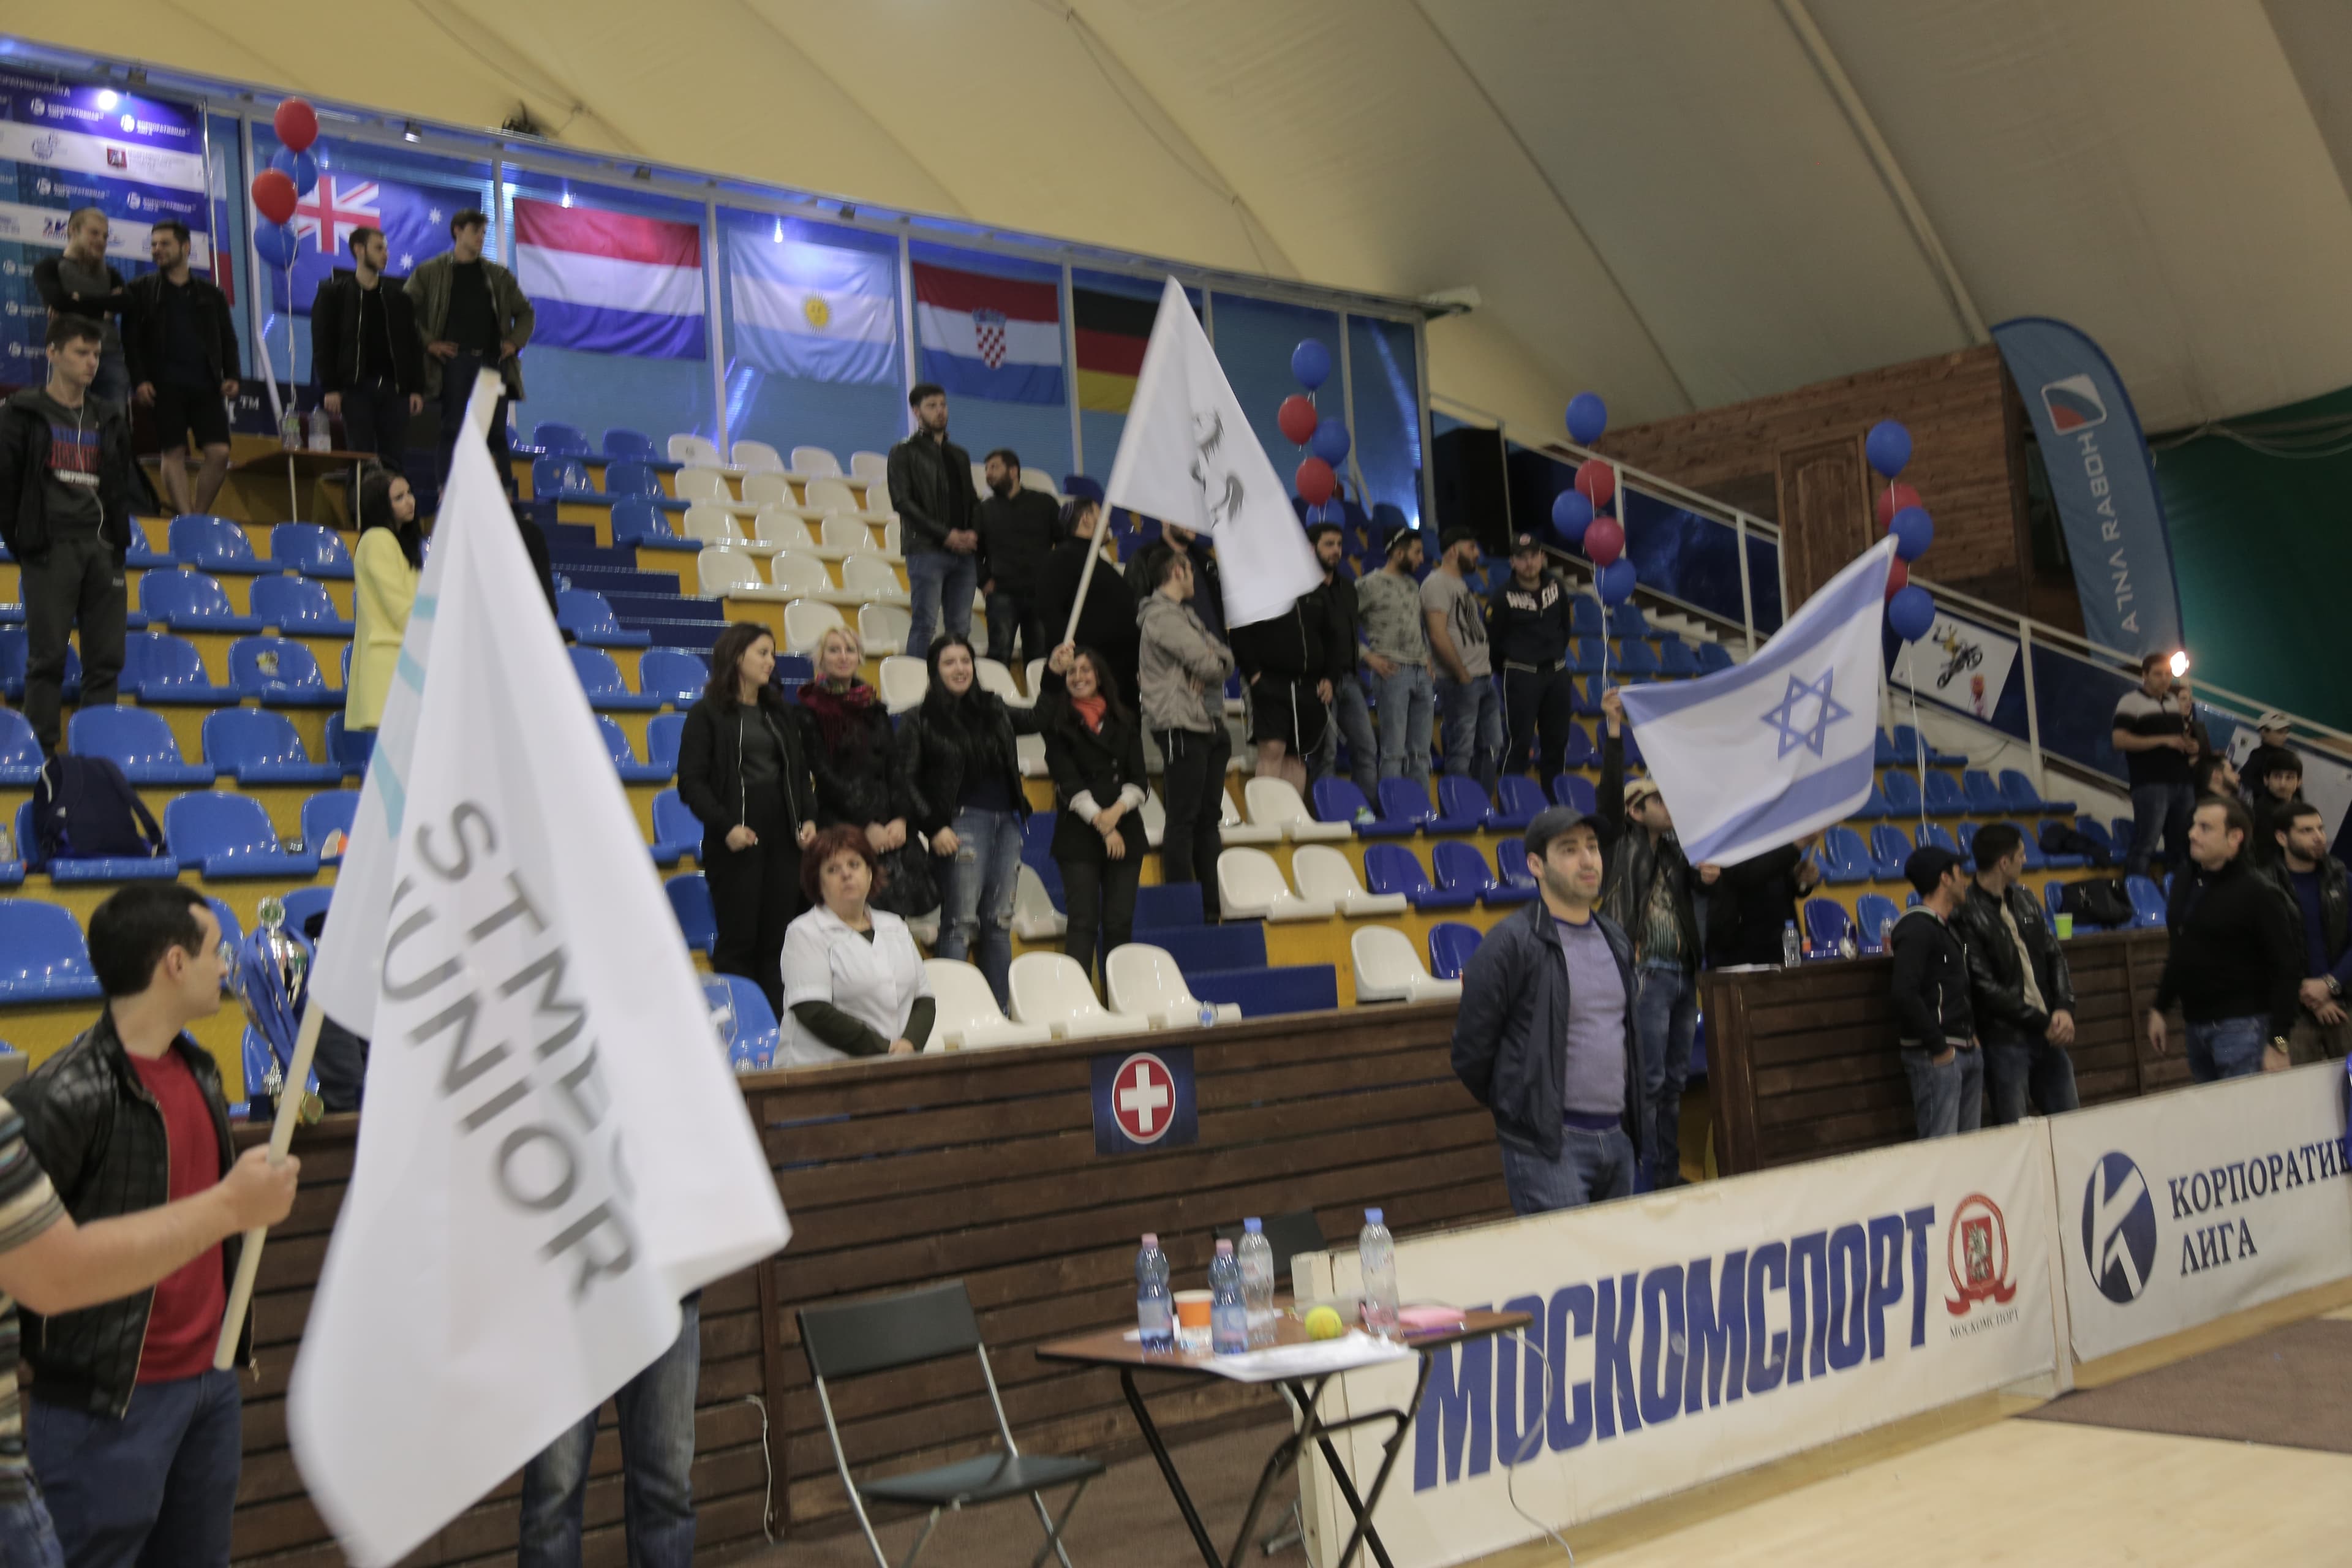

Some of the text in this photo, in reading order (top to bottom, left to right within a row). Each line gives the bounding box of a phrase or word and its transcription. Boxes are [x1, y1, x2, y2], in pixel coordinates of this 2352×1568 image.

[2180, 1217, 2258, 1277] ЛИГА
[1414, 1206, 1934, 1493] МОСКОМСПОРТ
[1950, 1307, 2019, 1340] МОСКОМСПОРТ
